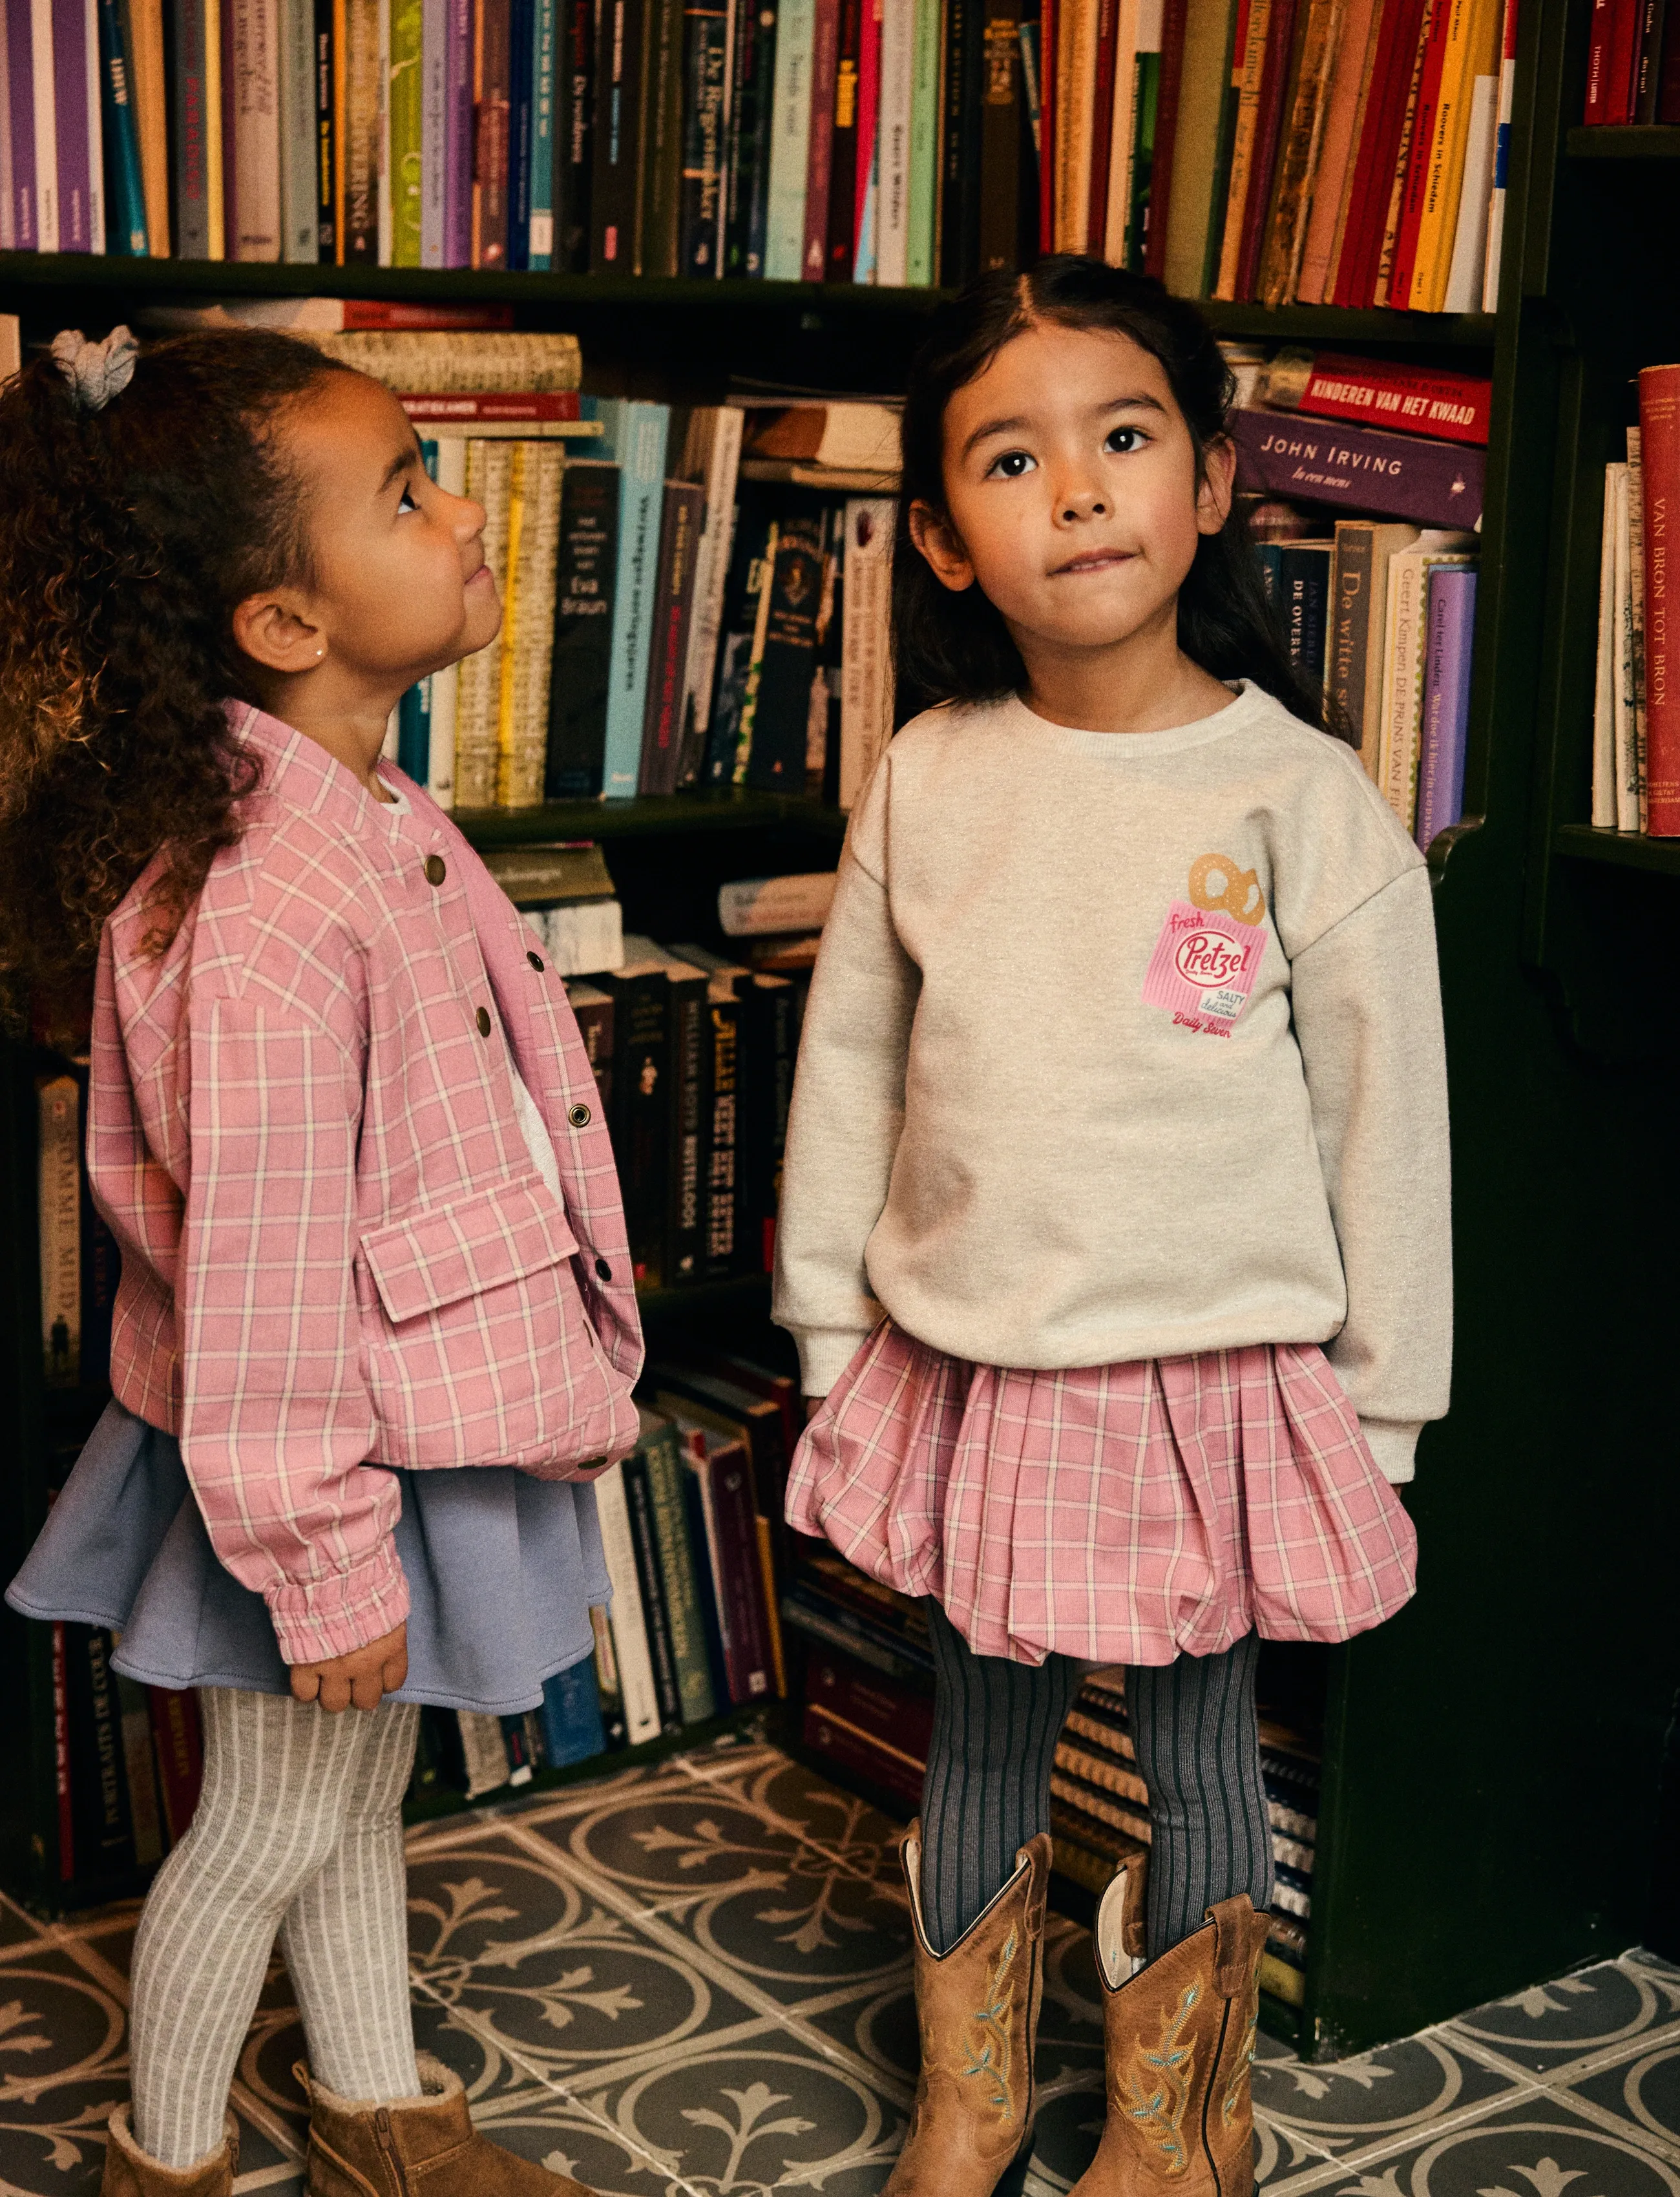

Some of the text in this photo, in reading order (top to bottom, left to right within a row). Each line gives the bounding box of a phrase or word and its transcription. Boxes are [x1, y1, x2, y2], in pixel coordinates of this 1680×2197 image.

[1592, 45, 1602, 78] THOTH
[1420, 103, 1431, 145] Roovers
[1438, 103, 1450, 145] Roovers
[1436, 149, 1444, 160] in
[1409, 163, 1424, 213] Schiedam
[1428, 163, 1442, 213] Schiedam
[1310, 378, 1374, 406] KINDEREN
[1374, 390, 1401, 413] VAN
[1402, 395, 1427, 417] HET
[1429, 399, 1476, 426] KWAAD
[1261, 434, 1403, 476] JOHN IRVING
[1291, 465, 1352, 489] In een mens
[625, 496, 651, 691] Verzwegen oorlogsjaren
[1293, 579, 1305, 601] DE
[1341, 571, 1362, 609] De
[1398, 569, 1415, 613] Geert
[1652, 497, 1666, 706] VAN BRON TOT BRON
[1436, 598, 1447, 629] Carel
[1336, 618, 1356, 678] witte
[1394, 617, 1411, 672] Kimpen
[1434, 631, 1445, 646] ter
[1431, 648, 1445, 686] Linden
[1396, 677, 1407, 698] DE
[1431, 693, 1442, 718] Wat
[1393, 701, 1407, 743] PRINS
[1429, 719, 1441, 737] doe
[1427, 751, 1439, 775] hier
[1428, 739, 1440, 750] ik
[1390, 749, 1404, 781] VAN
[1425, 777, 1437, 788] in
[1170, 911, 1204, 934] fresh
[1184, 936, 1251, 978] Pretzel
[1201, 998, 1237, 1018] delicious
[1217, 991, 1245, 1005] SALTY
[686, 1000, 699, 1080] WILLIAM
[1173, 1011, 1231, 1038] Daily Seven
[710, 1008, 737, 1257] ALLAH WEET HET BETER
[683, 1135, 698, 1228] RUSTELOOS
[57, 1131, 76, 1310] SOMME MUD
[88, 1636, 121, 1824] PORTRAITS DE COUR
